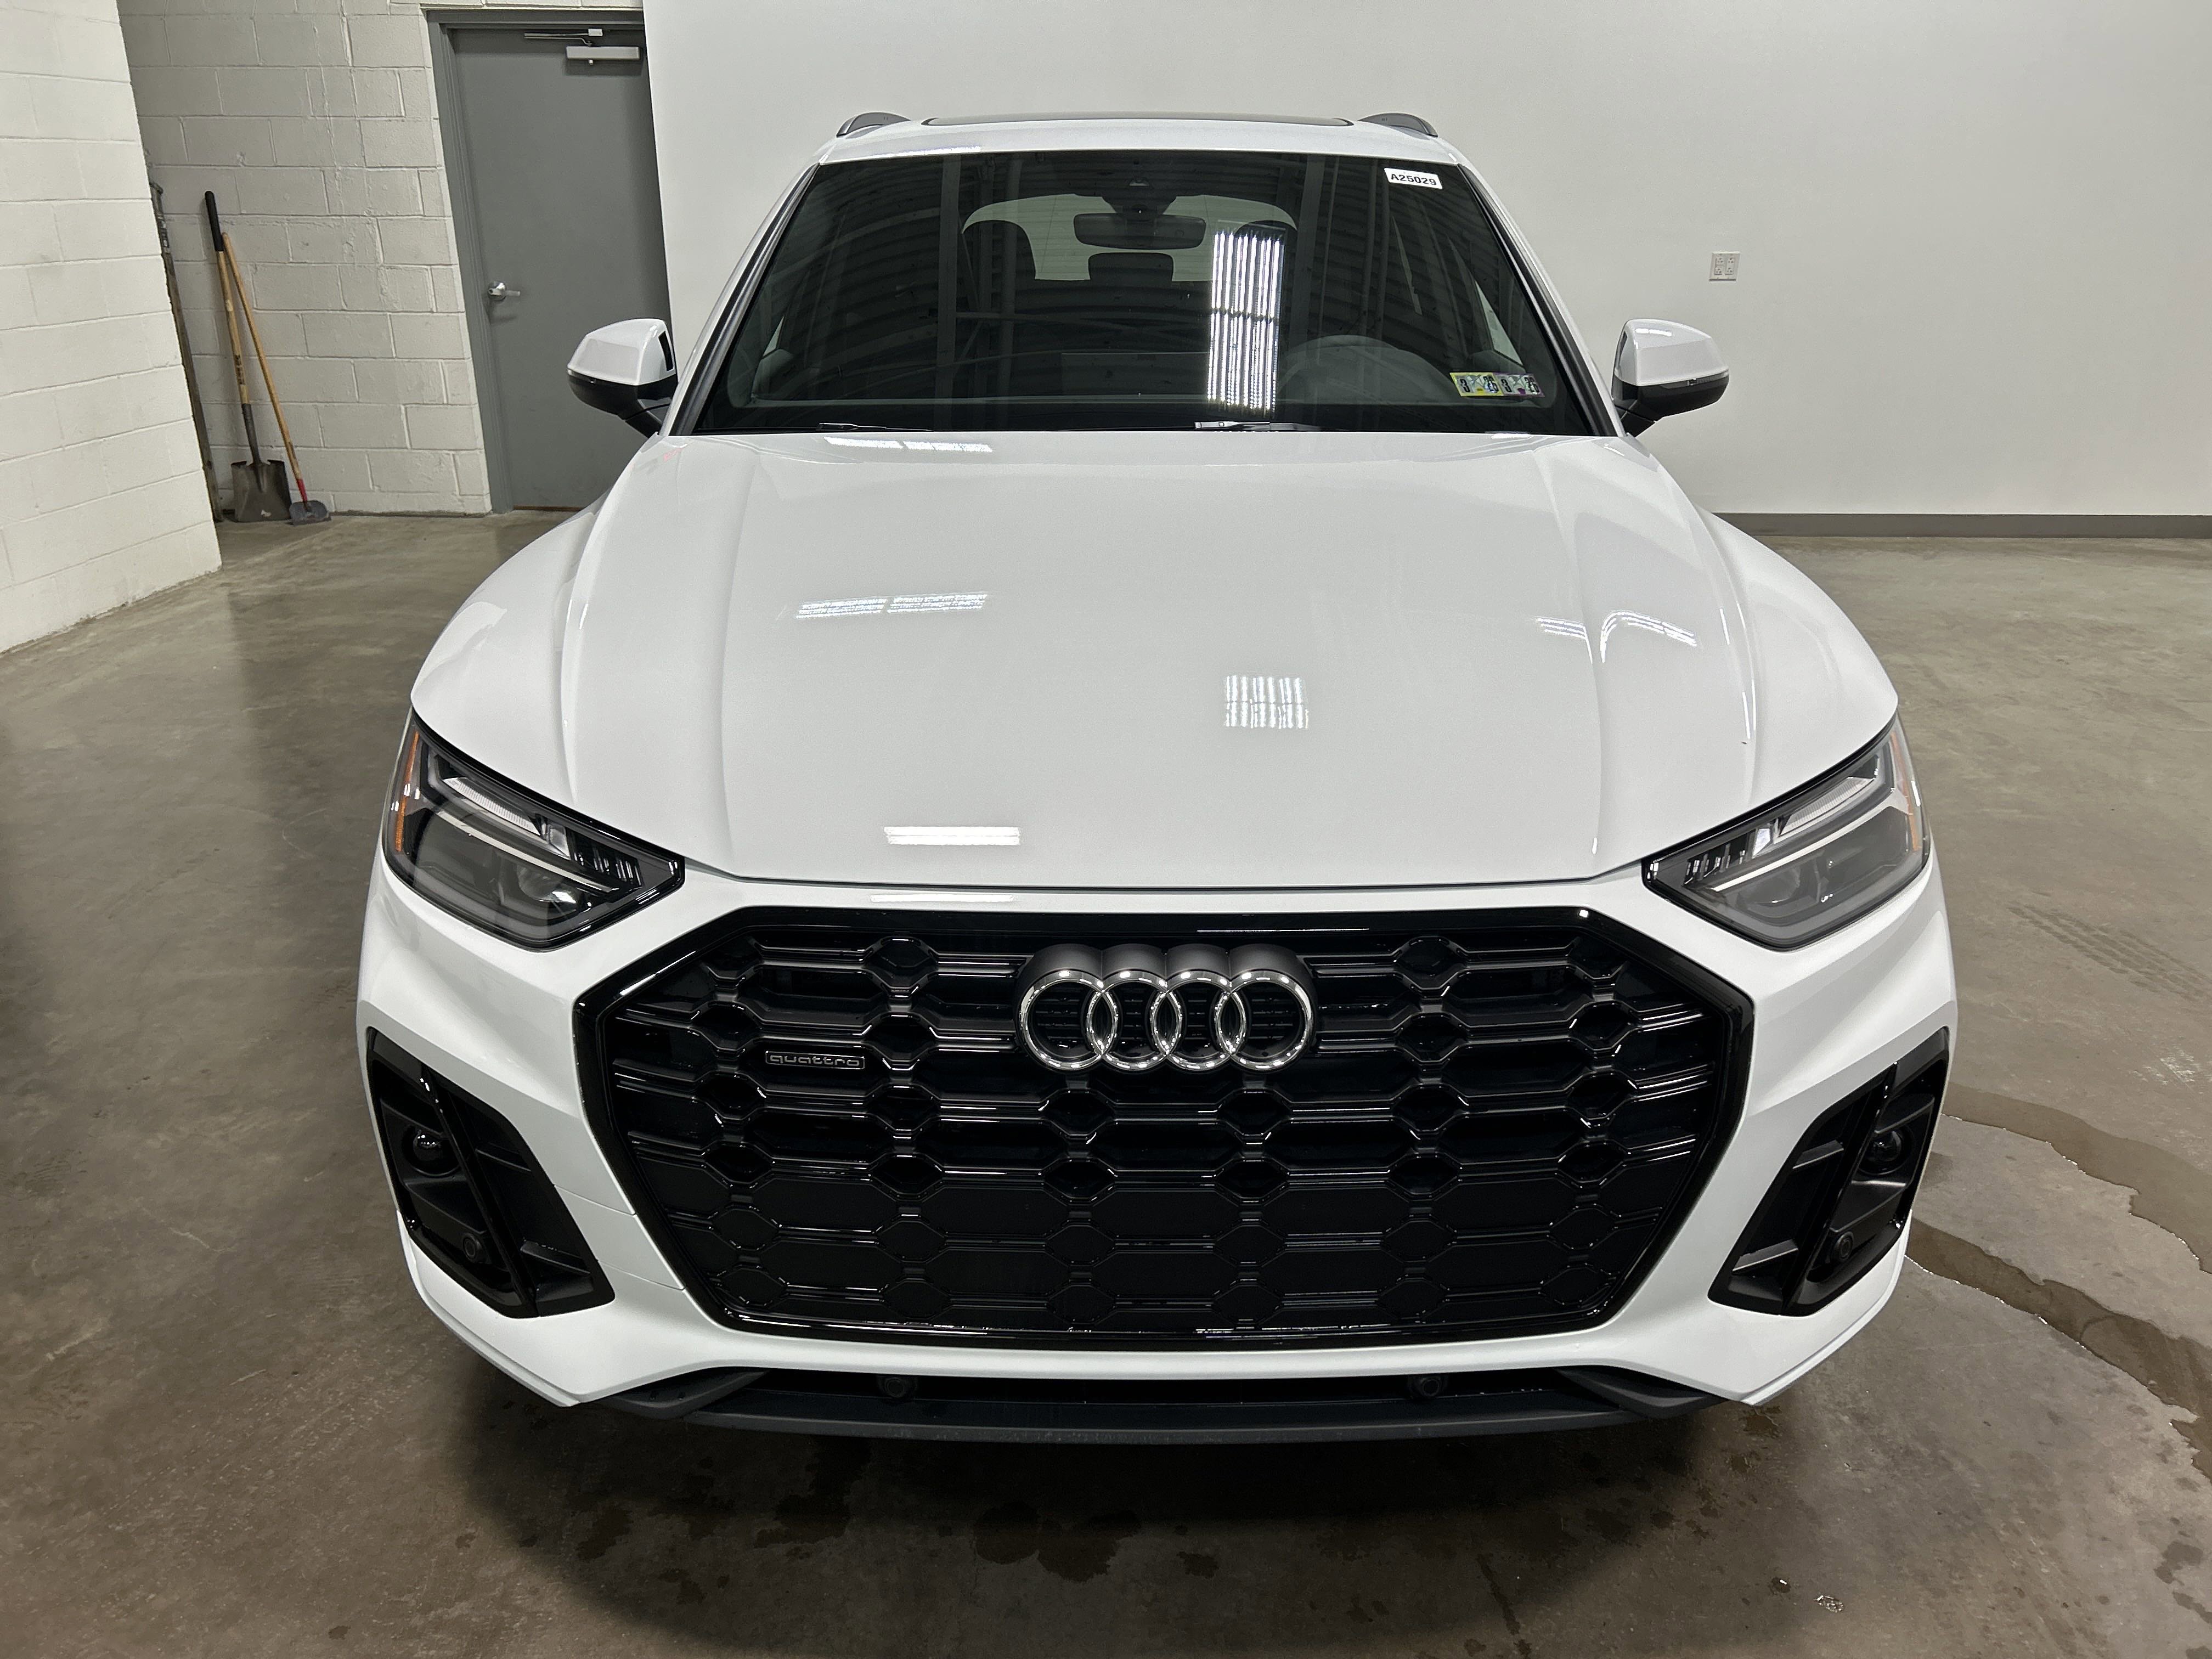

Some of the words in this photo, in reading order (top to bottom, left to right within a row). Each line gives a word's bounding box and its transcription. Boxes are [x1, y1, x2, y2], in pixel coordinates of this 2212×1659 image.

[1391, 173, 1437, 185] A25029
[1460, 379, 1471, 393] 3
[1501, 379, 1513, 393] 3
[769, 1054, 860, 1066] quattro
